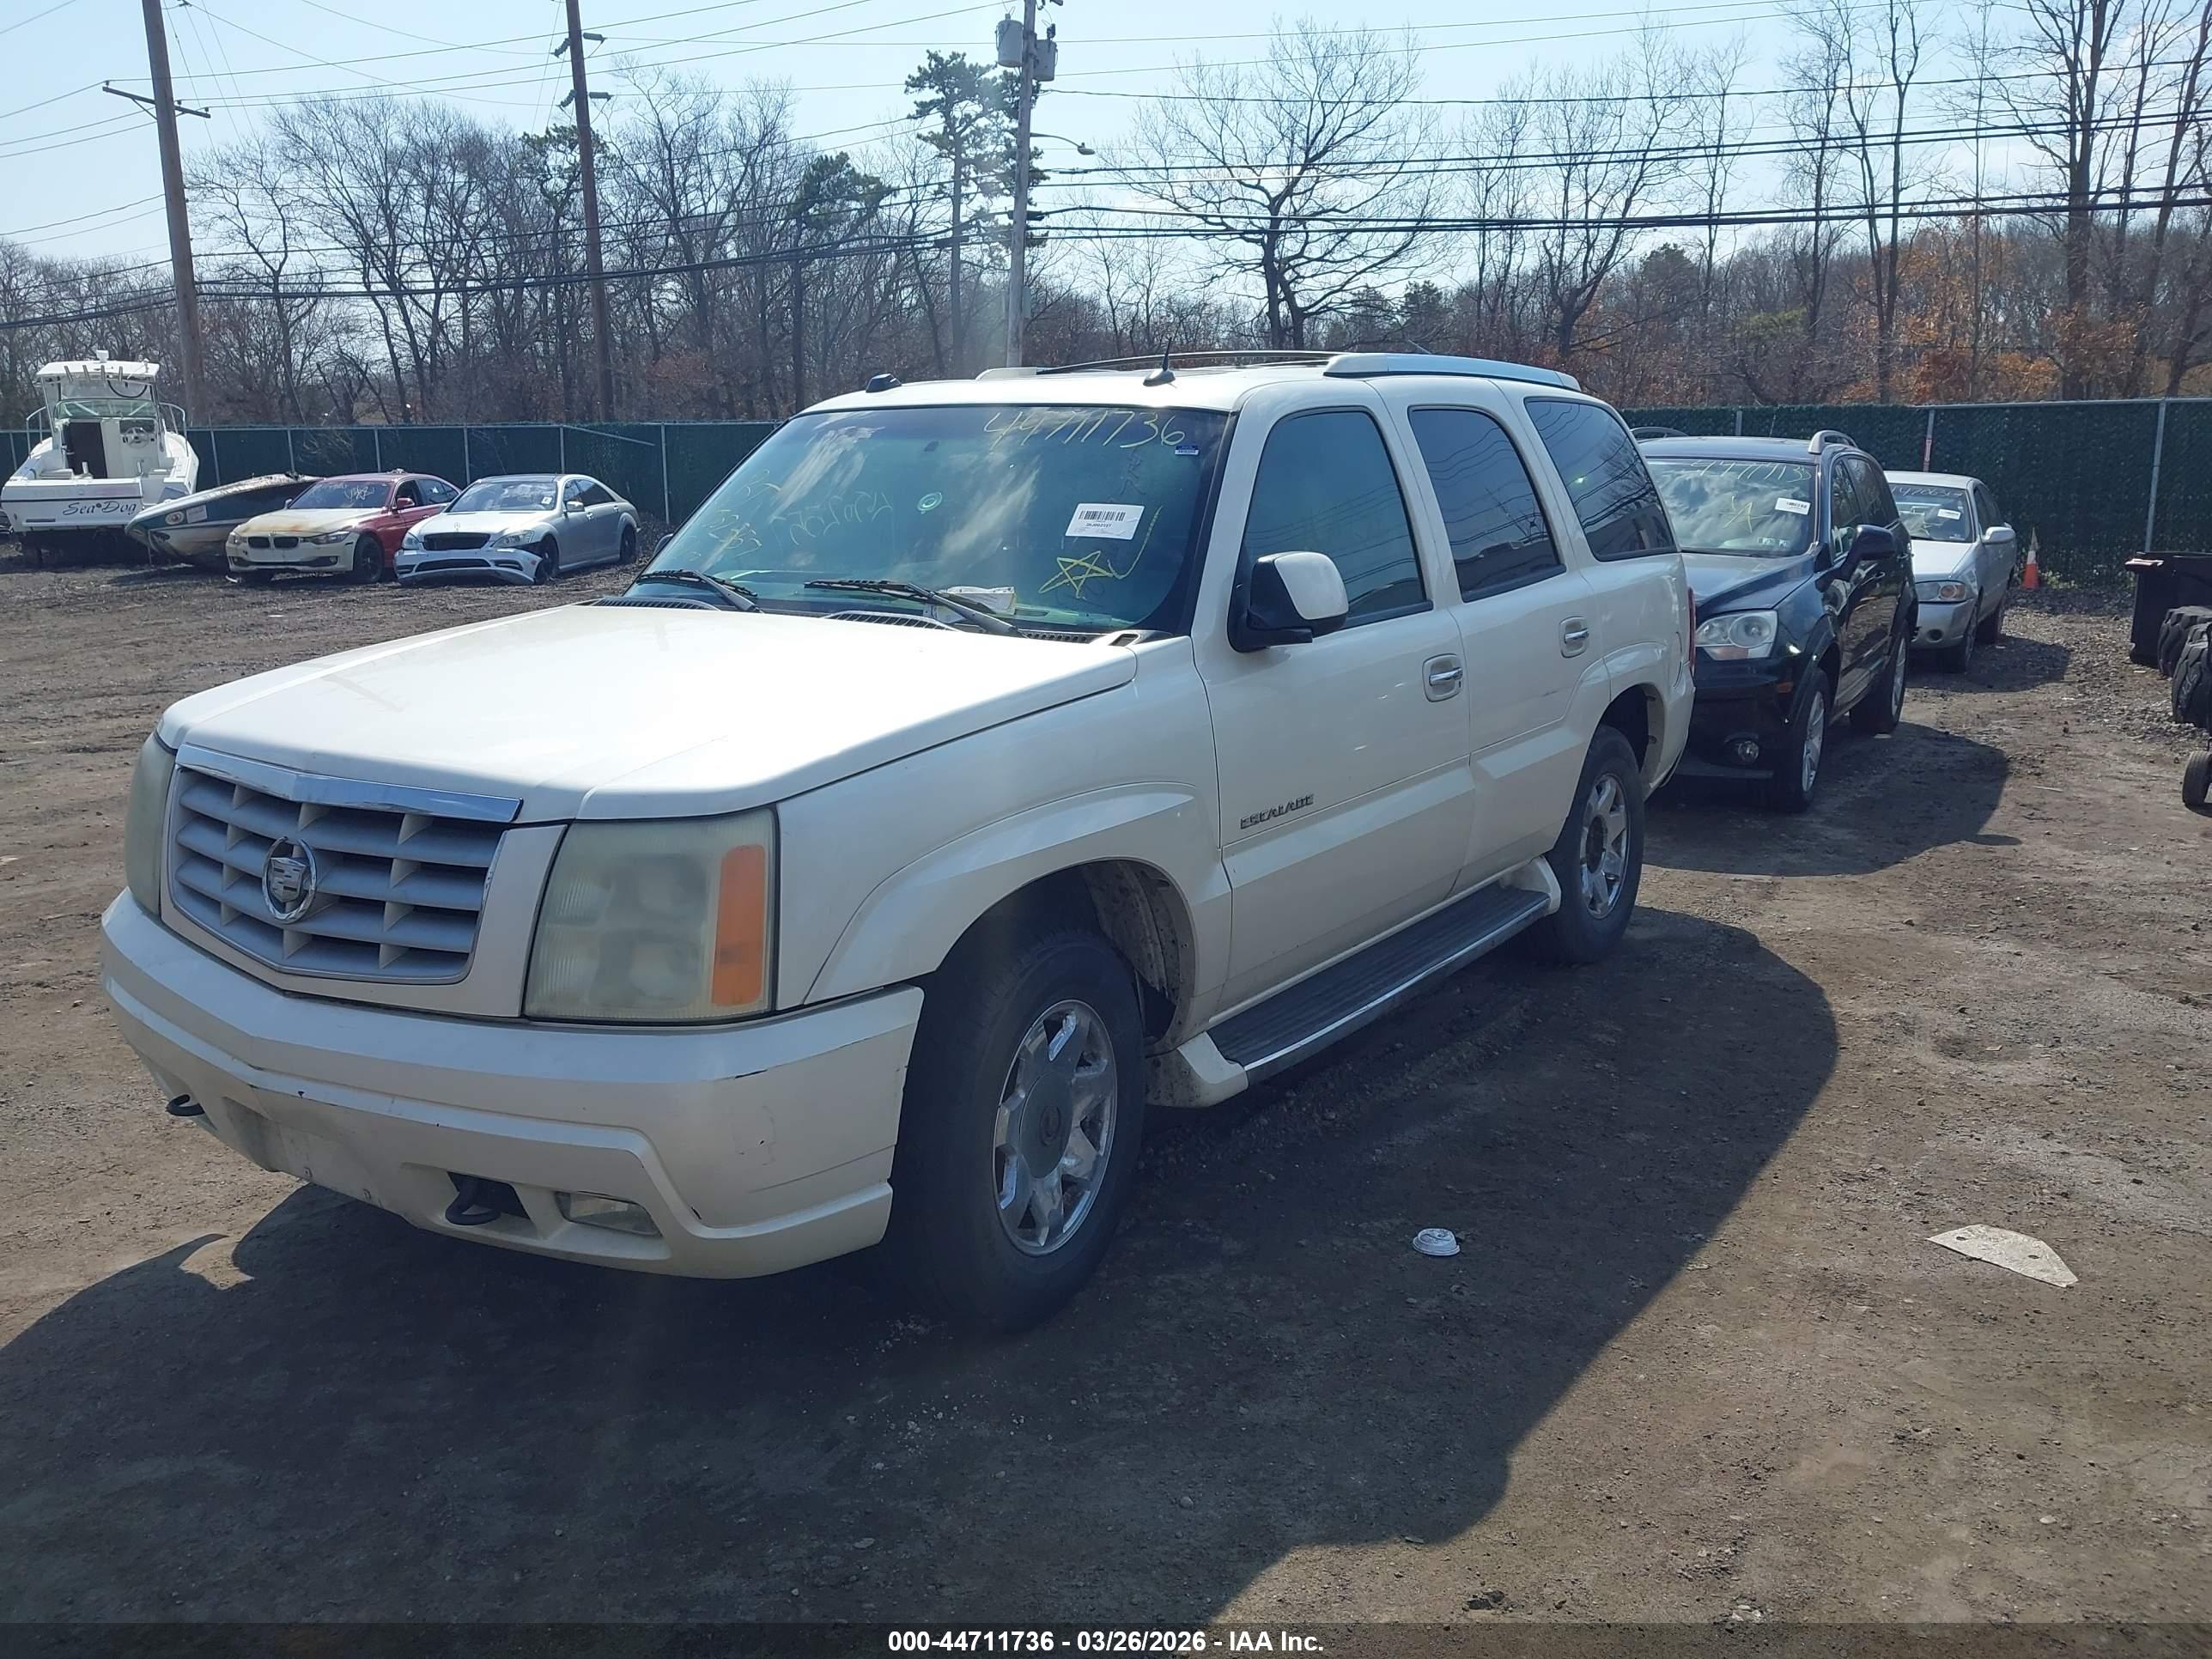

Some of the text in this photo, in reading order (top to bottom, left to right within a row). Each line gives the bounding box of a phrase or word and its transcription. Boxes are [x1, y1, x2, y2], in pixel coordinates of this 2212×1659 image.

[984, 410, 1186, 455] 44711736
[62, 500, 137, 516] Sea Dog
[1240, 793, 1315, 830] ESCALADE
